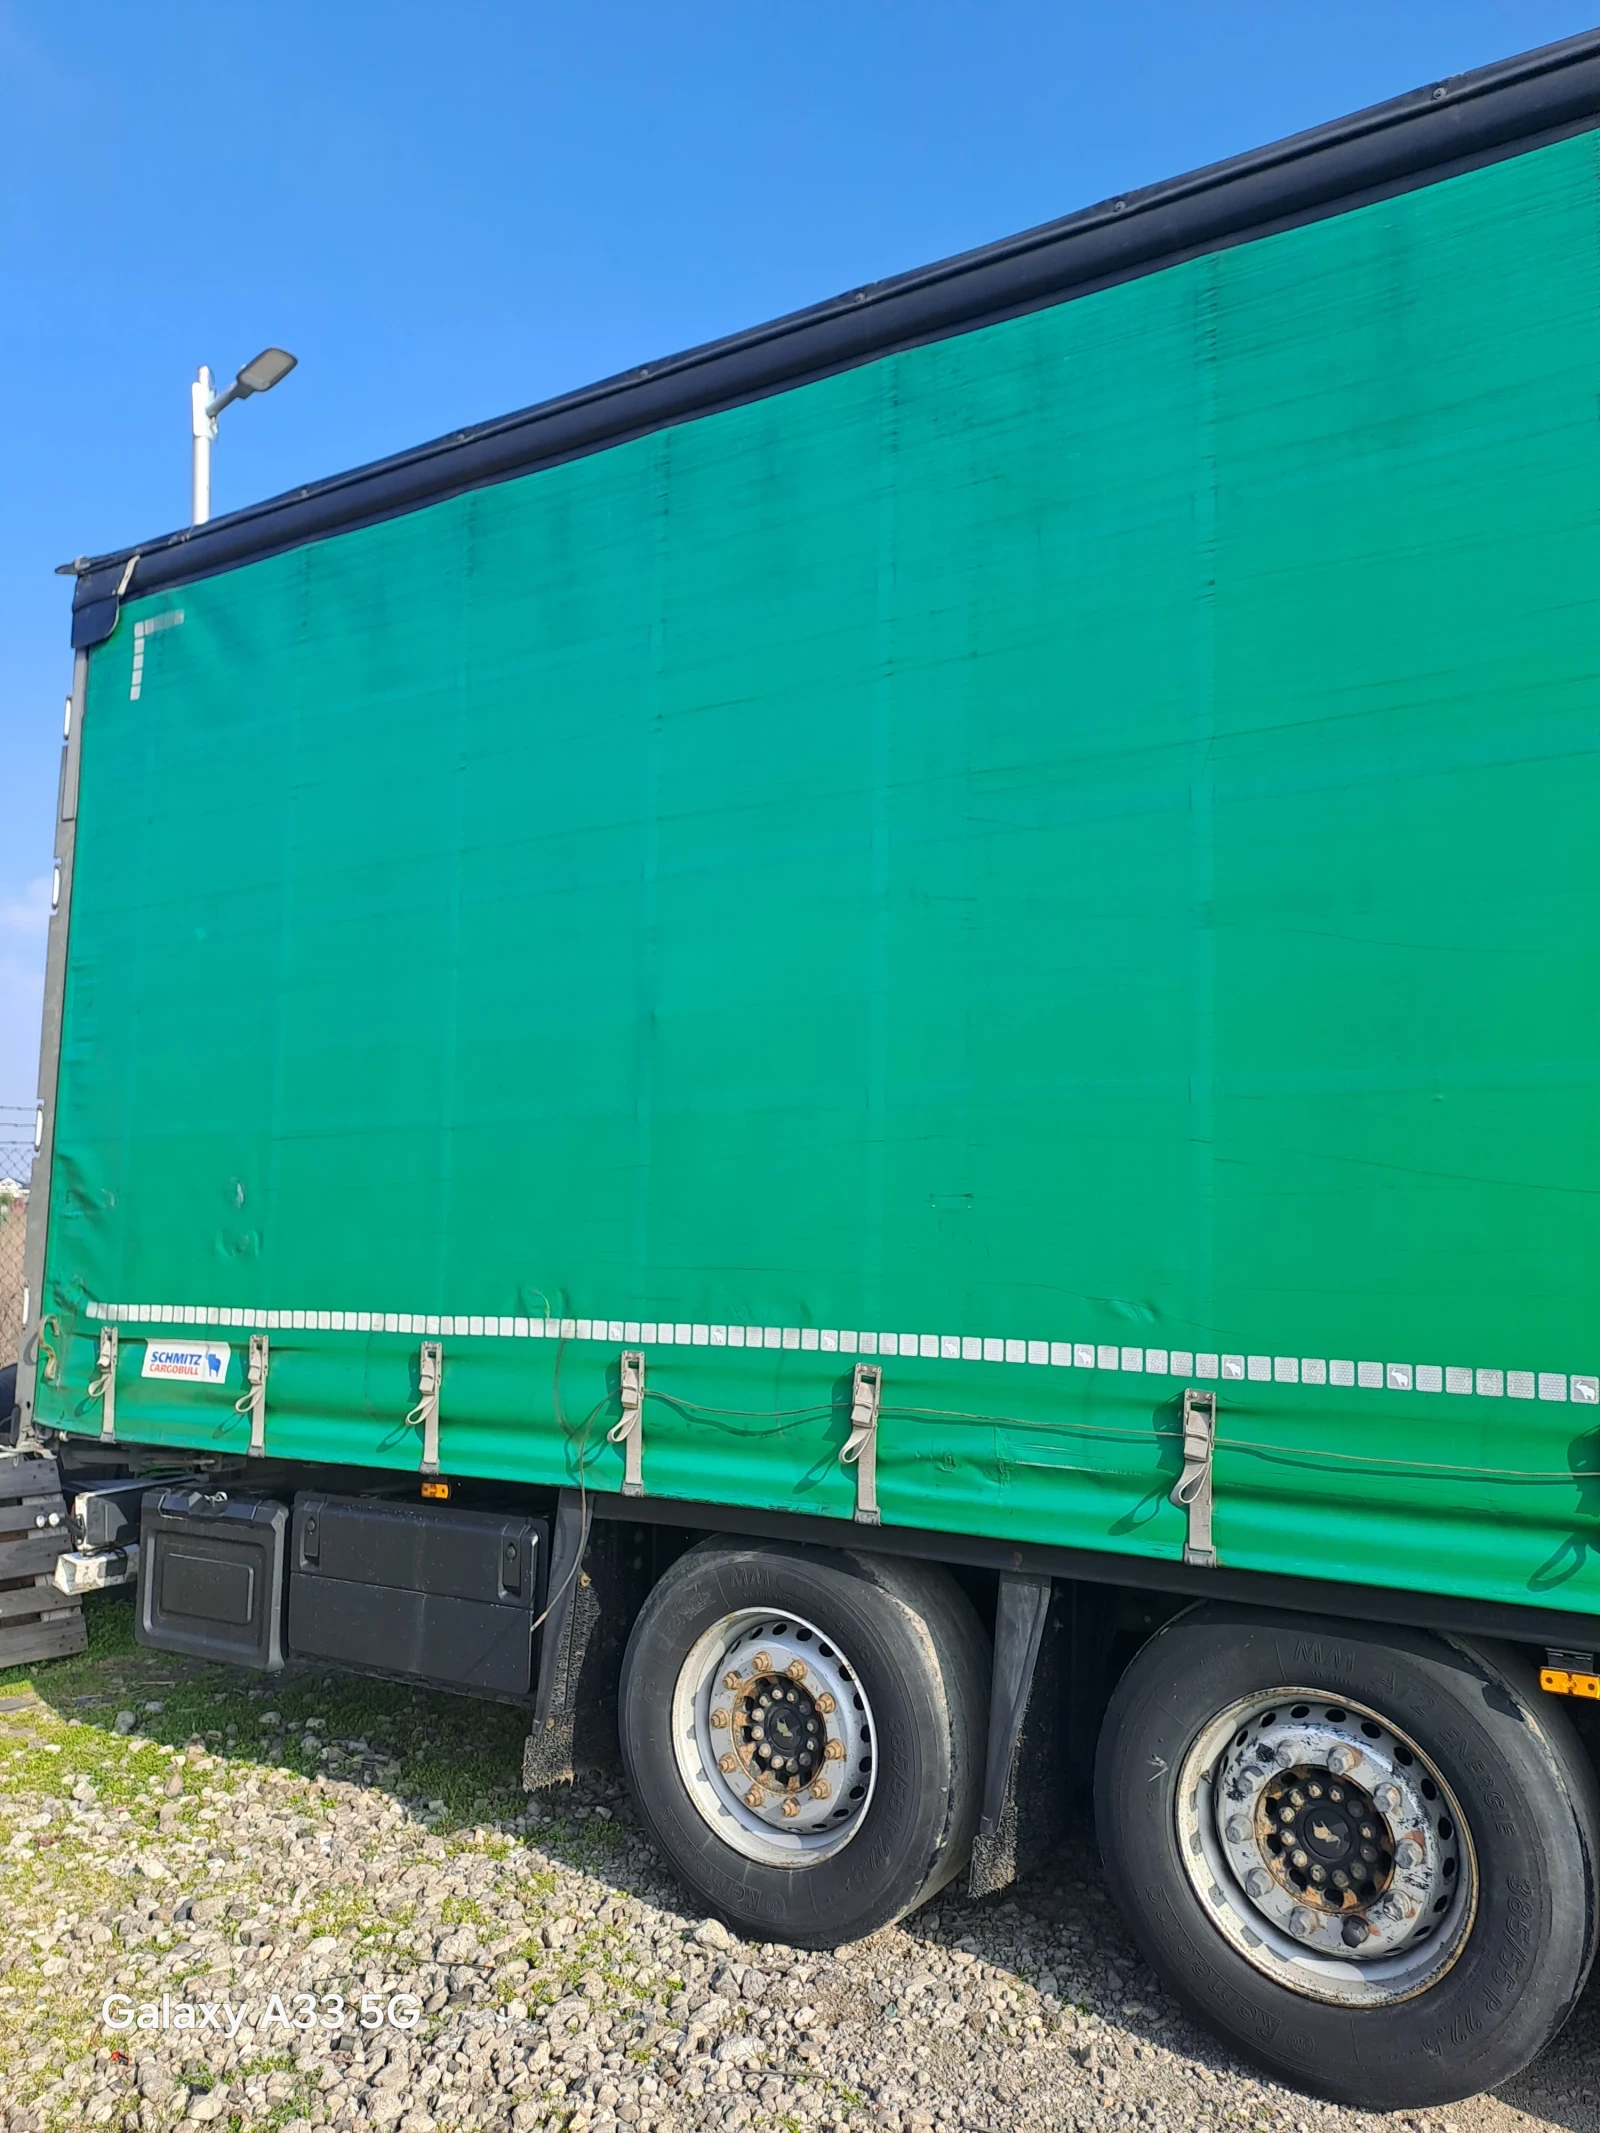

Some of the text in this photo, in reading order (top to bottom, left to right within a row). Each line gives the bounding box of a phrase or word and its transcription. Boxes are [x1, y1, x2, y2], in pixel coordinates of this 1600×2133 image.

[149, 1363, 199, 1376] CARGOBULL
[150, 1351, 203, 1366] SCHMITZ
[1292, 1639, 1356, 1672] MM
[888, 1716, 909, 1814] 385/55
[1491, 1871, 1533, 1994] 385/55
[1482, 1984, 1504, 2014] R
